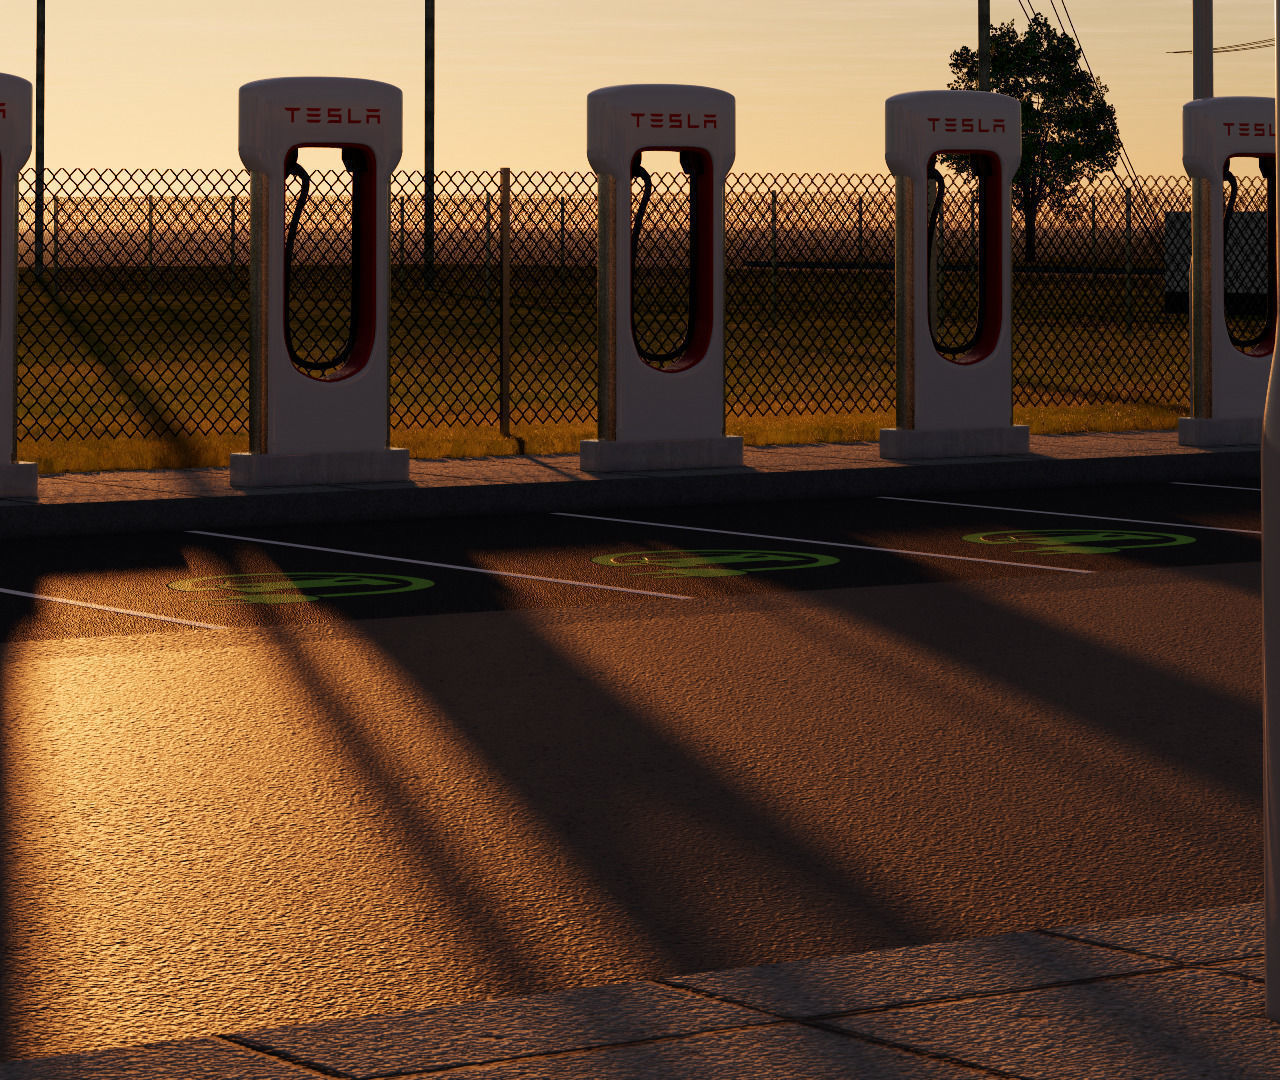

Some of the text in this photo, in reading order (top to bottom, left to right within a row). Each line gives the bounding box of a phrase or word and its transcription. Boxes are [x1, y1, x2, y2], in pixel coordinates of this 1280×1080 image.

[285, 107, 381, 125] TESLA
[631, 112, 718, 129] TESLA
[927, 117, 1005, 133] TESLA
[1223, 122, 1275, 137] TESL
